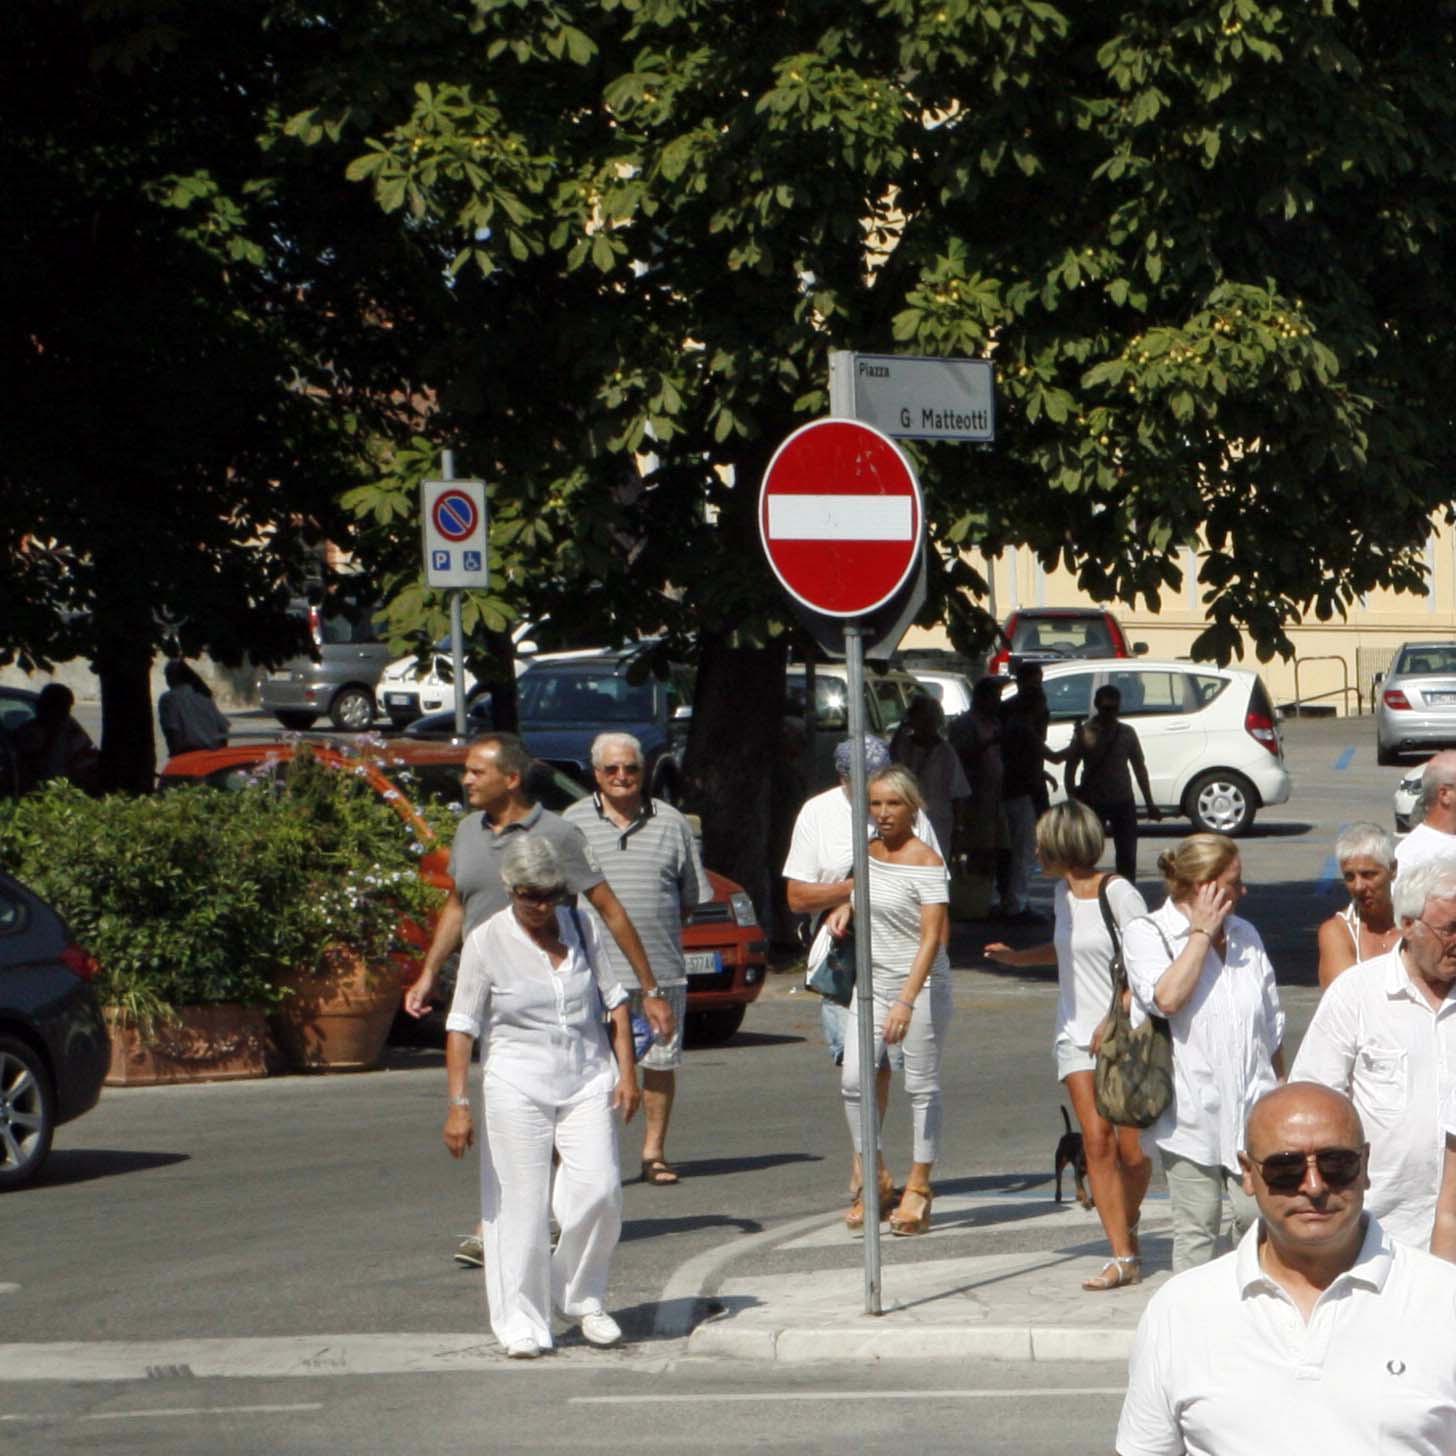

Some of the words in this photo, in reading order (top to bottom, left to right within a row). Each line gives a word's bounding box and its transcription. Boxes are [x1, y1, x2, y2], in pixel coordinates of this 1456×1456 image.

[859, 362, 890, 378] Piazza
[922, 408, 988, 430] Matteotti
[436, 552, 448, 569] P
